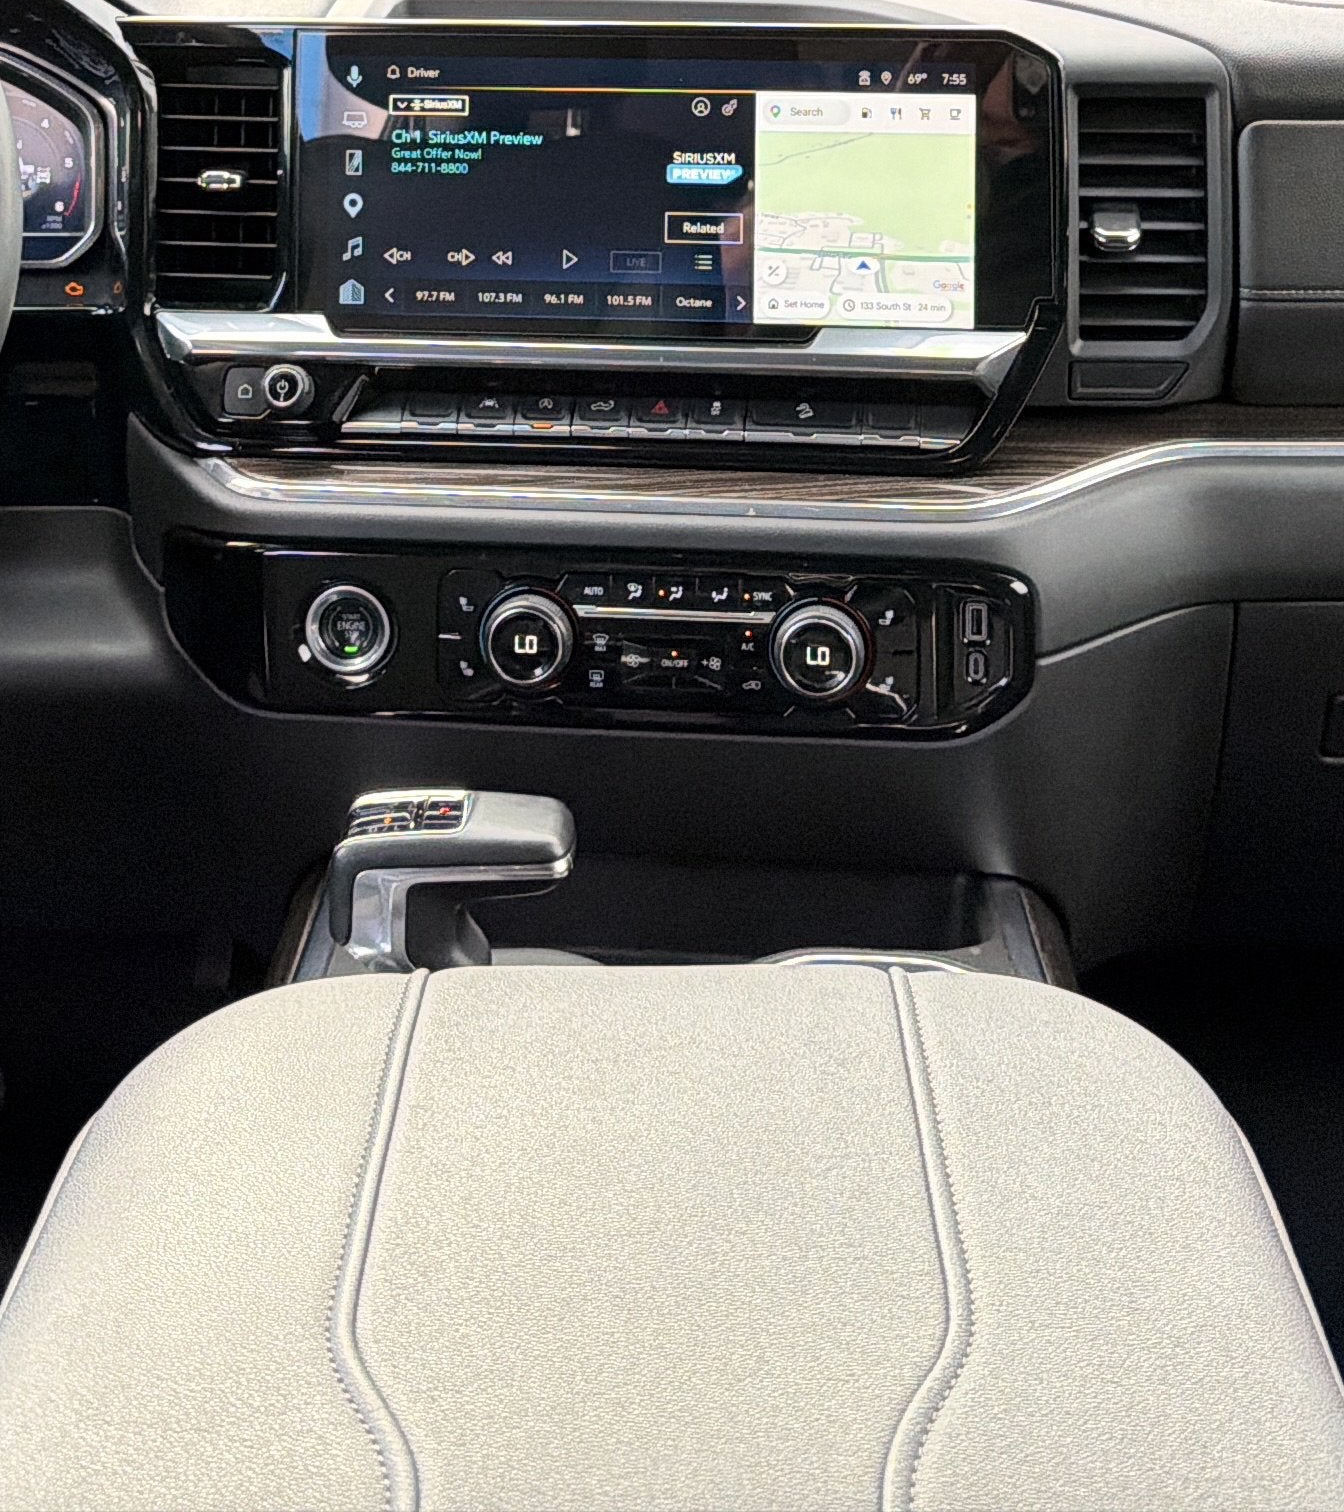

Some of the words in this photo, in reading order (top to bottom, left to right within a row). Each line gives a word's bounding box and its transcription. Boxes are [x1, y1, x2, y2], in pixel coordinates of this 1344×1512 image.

[408, 67, 440, 78] Driver
[908, 73, 928, 86] 69°
[942, 73, 967, 86] 7:55
[425, 100, 462, 110] SiriusXM
[790, 107, 823, 117] Search
[40, 118, 50, 129] 4
[392, 130, 409, 144] Ch
[415, 131, 421, 144] 1
[429, 130, 486, 144] SiriusXM
[490, 131, 543, 145] Preview
[392, 148, 421, 160] Great
[425, 148, 452, 160] Offer
[455, 148, 482, 160] Now!
[672, 152, 735, 164] SIRIUSXM
[64, 158, 74, 168] 5
[391, 162, 469, 174] 844-711-8800
[672, 168, 732, 180] PREVIEW
[55, 202, 64, 212] 6
[682, 222, 724, 234] Related
[397, 251, 411, 260] CH
[448, 252, 461, 262] CH
[626, 257, 646, 267] LIVE
[933, 279, 964, 292] Google
[416, 291, 437, 301] 97.7
[440, 292, 455, 302] FM
[478, 292, 504, 302] 107.3
[507, 293, 522, 303] FM
[544, 294, 565, 304] 96.1
[568, 295, 583, 304] FM
[607, 295, 634, 305] 101.5
[636, 296, 652, 306] FM
[676, 296, 712, 308] Octane
[784, 299, 797, 309] Set
[799, 300, 825, 310] Home
[877, 301, 900, 311] South
[902, 301, 911, 311] St
[918, 302, 928, 312] 24
[930, 303, 946, 312] min
[584, 587, 603, 595] AUTO
[753, 592, 772, 601] SYNC
[514, 635, 537, 653] LO
[741, 643, 754, 651] A/C
[806, 647, 830, 665] LO
[661, 659, 688, 667] ON/OFF
